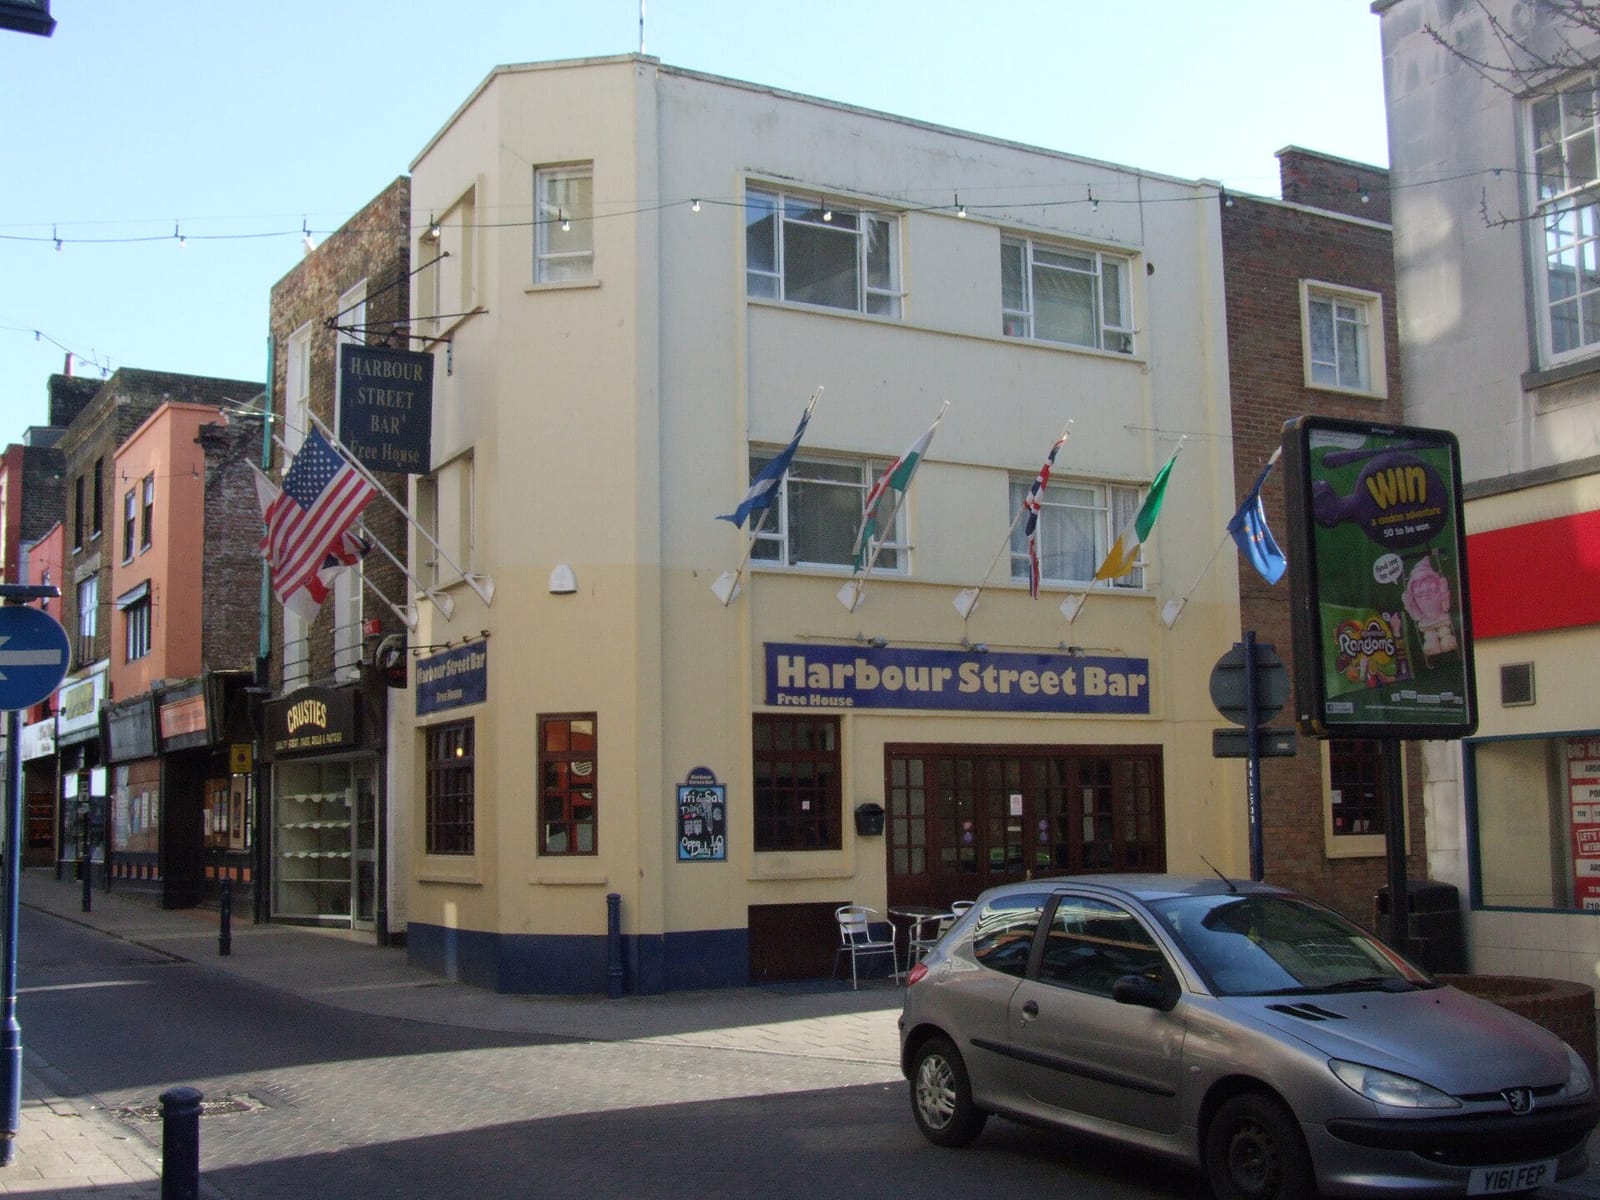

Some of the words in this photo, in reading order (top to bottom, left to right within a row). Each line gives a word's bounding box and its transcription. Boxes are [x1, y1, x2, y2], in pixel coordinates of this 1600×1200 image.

[351, 357, 422, 381] HARBOUR
[358, 387, 414, 408] STREET
[371, 415, 400, 434] BAR
[350, 440, 378, 459] Free
[382, 443, 420, 463] House
[1384, 528, 1394, 538] 50
[1395, 528, 1404, 536] to
[1404, 525, 1415, 534] be
[1340, 634, 1394, 656] Randoms
[416, 665, 446, 686] Harbour
[446, 656, 470, 676] Street
[470, 653, 485, 670] Bar
[777, 655, 952, 692] Harbour
[958, 662, 1077, 695] Street
[1083, 666, 1146, 697] Bar
[777, 693, 807, 705] Free
[810, 694, 853, 706] House
[287, 700, 326, 733] CRUSTIES
[1516, 1165, 1546, 1188] FEP
